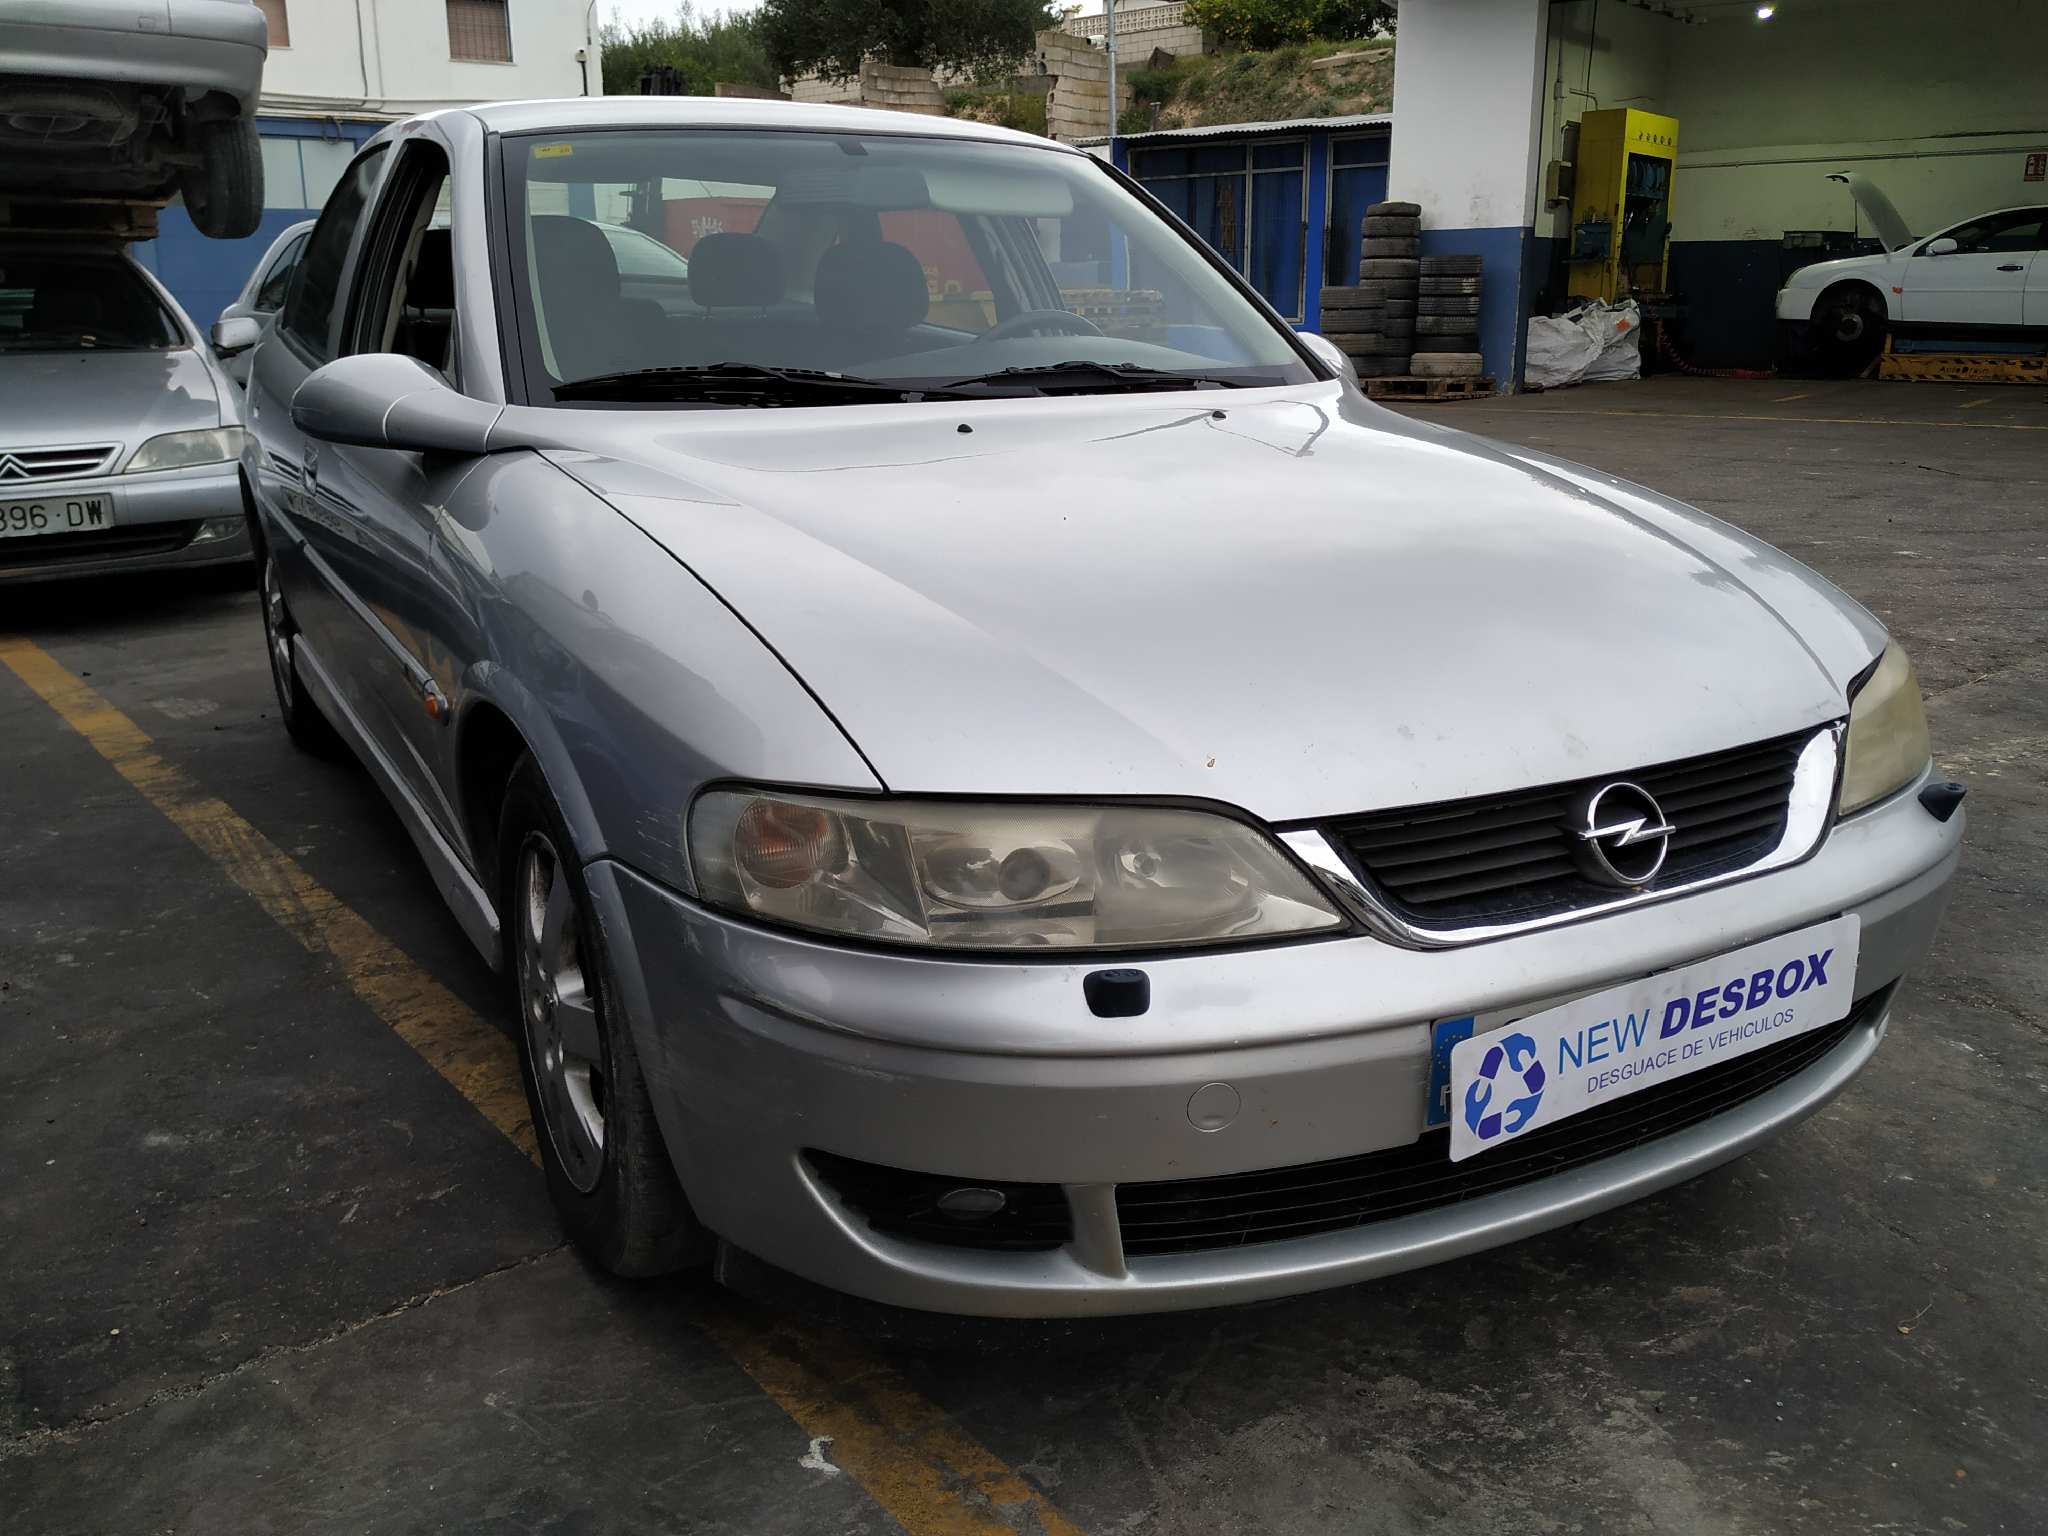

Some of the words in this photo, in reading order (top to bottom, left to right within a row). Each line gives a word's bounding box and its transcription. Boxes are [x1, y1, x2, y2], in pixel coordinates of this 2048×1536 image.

[1559, 1008, 1650, 1075] NEW
[1660, 949, 1834, 1040] DESBOX
[1588, 1048, 1678, 1093] DESGUACE
[1682, 1039, 1704, 1060] DE
[1708, 1008, 1794, 1050] VEHICULOS
